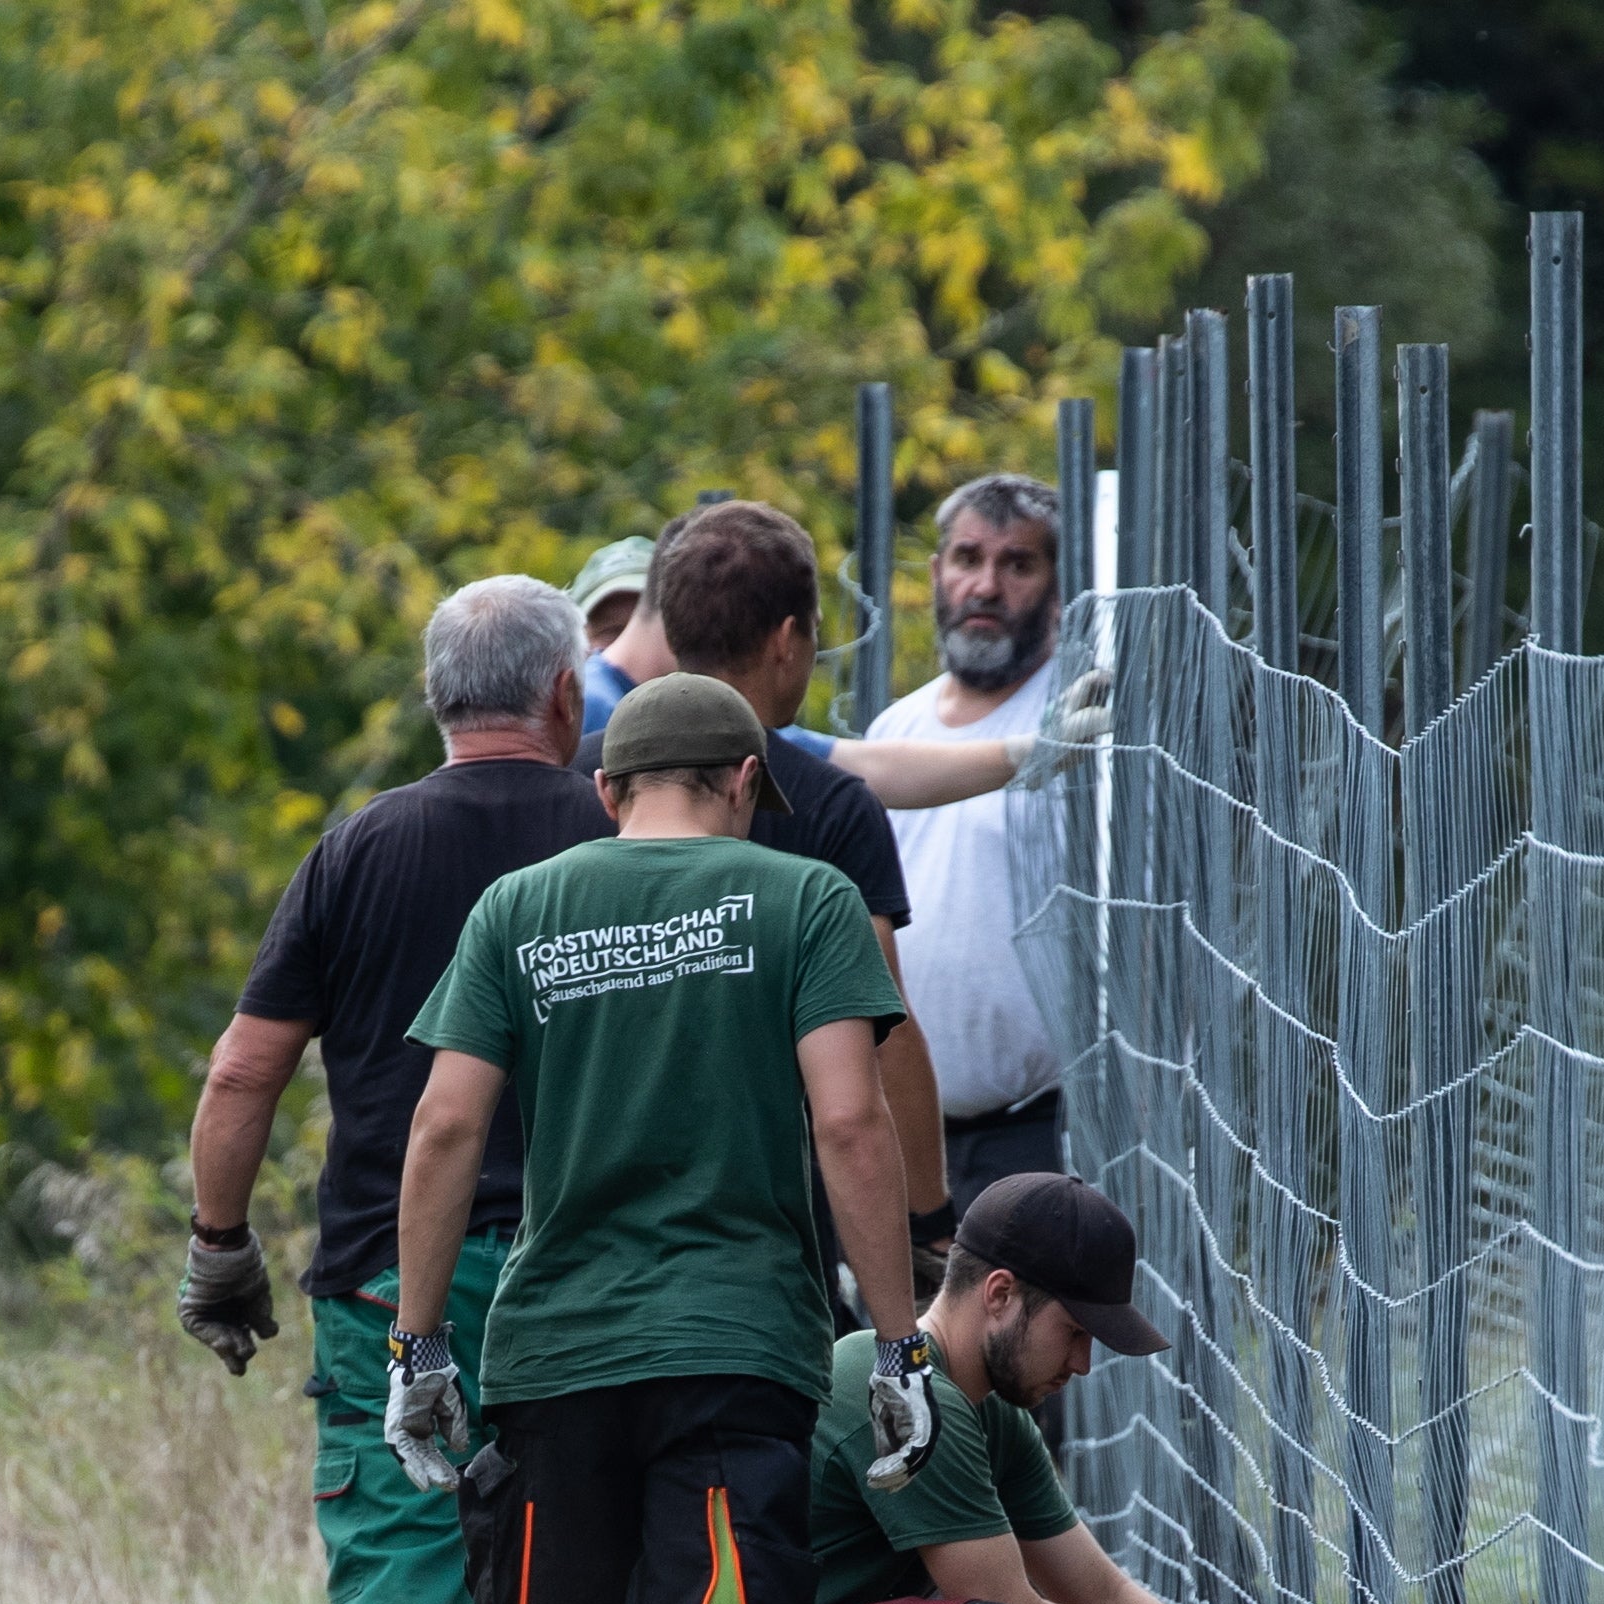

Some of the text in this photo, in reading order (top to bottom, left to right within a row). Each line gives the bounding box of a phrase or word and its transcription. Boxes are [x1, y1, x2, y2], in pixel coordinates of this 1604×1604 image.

[527, 903, 744, 970] FORSTWIRTSCHAFT
[647, 968, 674, 987] aus
[674, 952, 743, 978] Tradition
